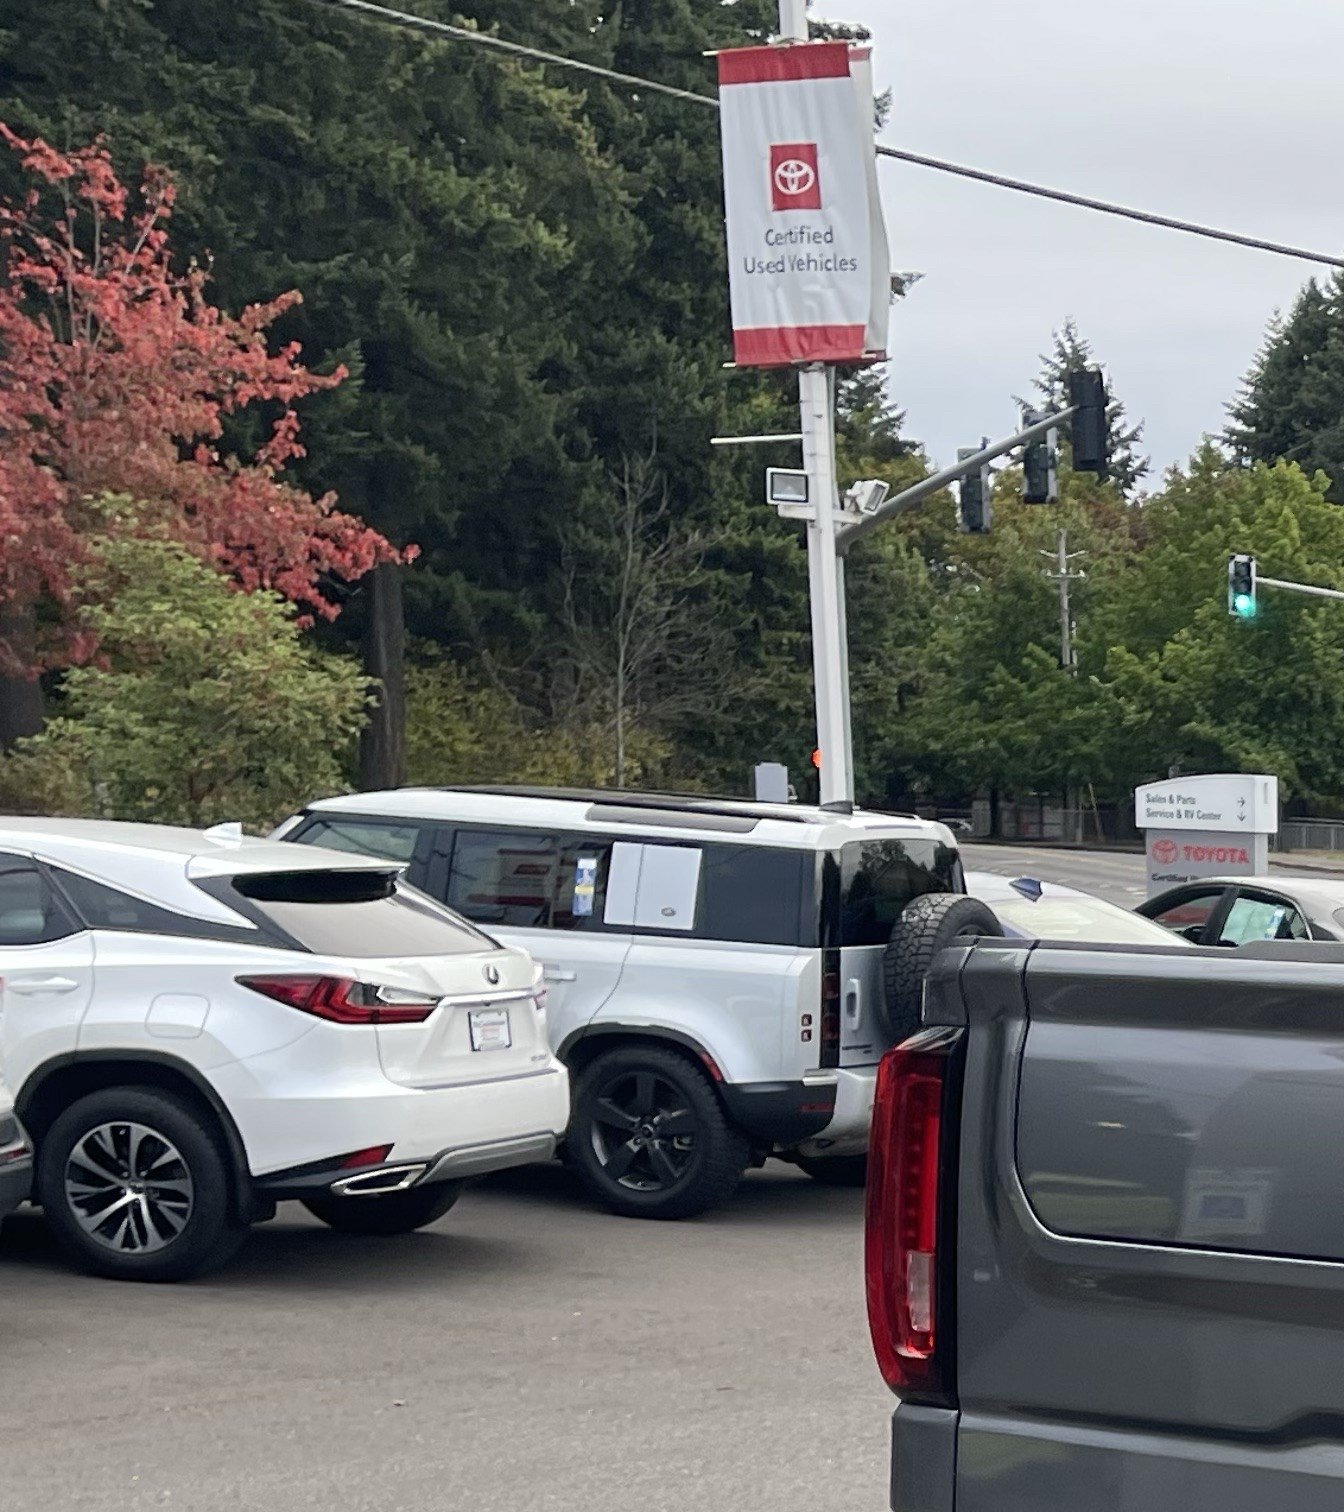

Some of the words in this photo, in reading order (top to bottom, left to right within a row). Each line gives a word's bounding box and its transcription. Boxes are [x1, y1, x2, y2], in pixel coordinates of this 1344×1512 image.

[765, 225, 834, 246] Certified
[743, 254, 785, 274] Used
[788, 253, 858, 272] Vehicles
[1146, 793, 1167, 804] Sales
[1169, 794, 1175, 804] &
[1183, 845, 1250, 864] TOYOTA
